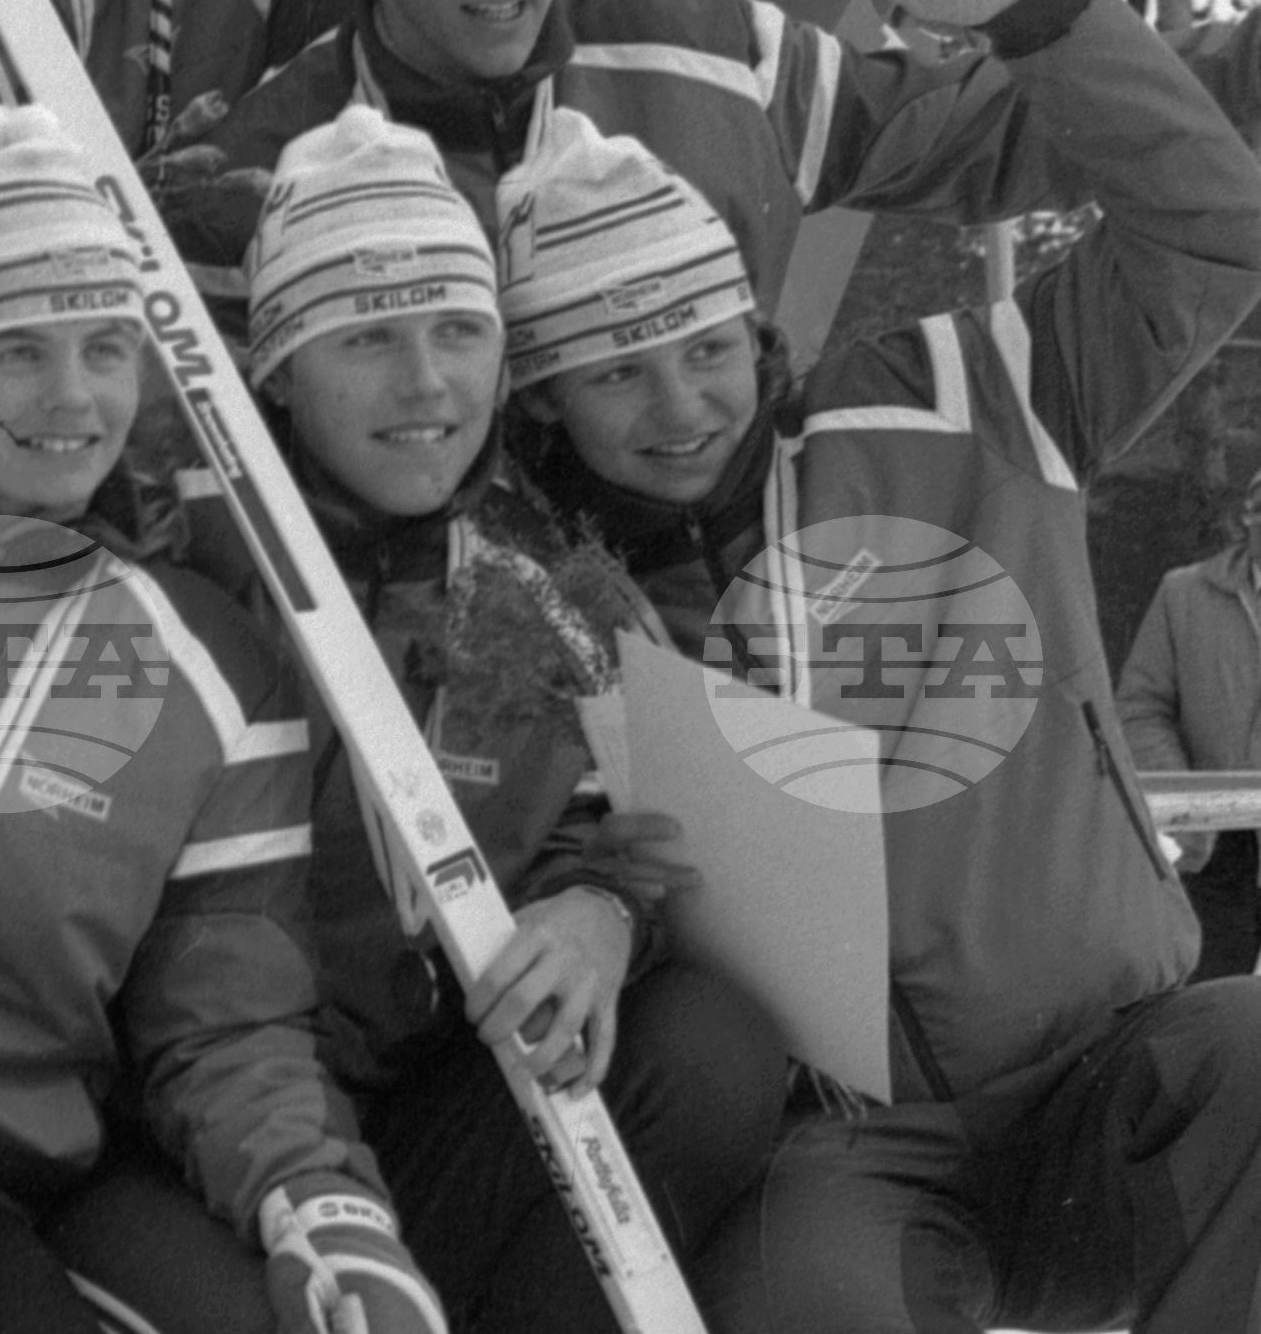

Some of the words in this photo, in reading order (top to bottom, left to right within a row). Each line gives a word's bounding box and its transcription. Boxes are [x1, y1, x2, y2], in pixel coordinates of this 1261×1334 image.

[49, 291, 130, 314] SKILOM
[353, 284, 447, 315] SKILOM
[611, 305, 698, 349] SKILOM
